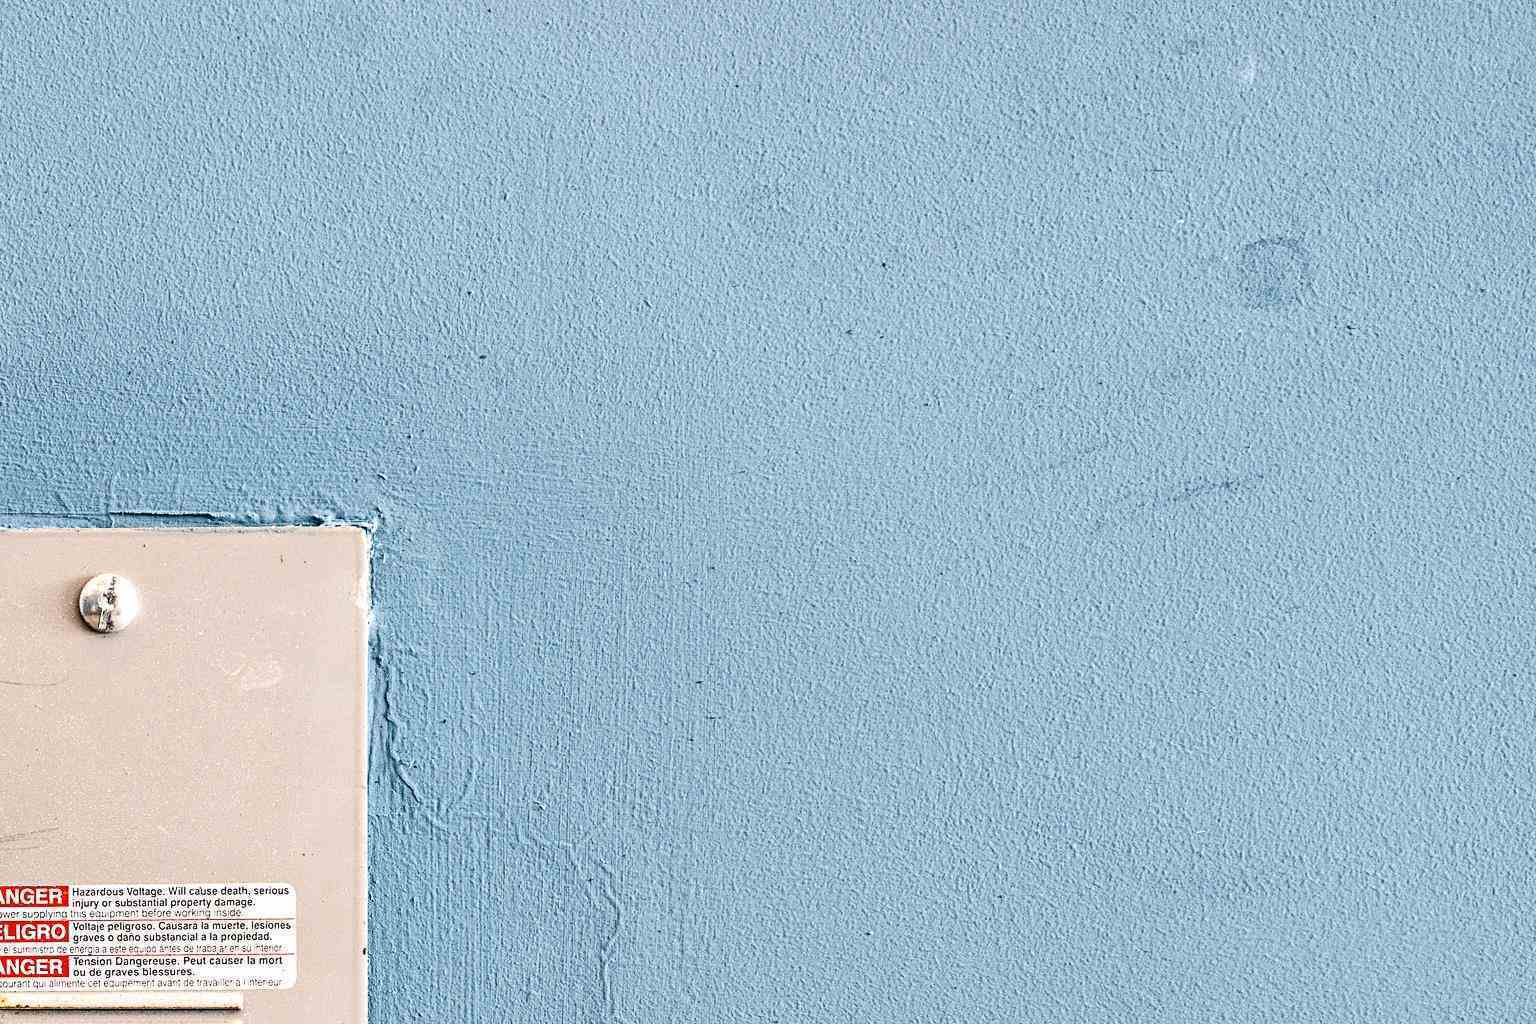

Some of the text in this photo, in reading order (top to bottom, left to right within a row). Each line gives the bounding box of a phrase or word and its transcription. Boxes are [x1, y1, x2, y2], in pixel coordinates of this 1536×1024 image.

[72, 886, 289, 898] Hazardous Voltage. Will cause death, serious
[72, 898, 256, 909] injury or substantial property damage.
[141, 909, 172, 918] before
[73, 922, 105, 932] Voltaje
[107, 921, 156, 933] peligroso.
[201, 921, 210, 930] la
[251, 921, 292, 930] lesiones
[73, 934, 105, 944] graves
[107, 934, 115, 942] o
[143, 932, 198, 942] substancial
[201, 933, 207, 941] a
[209, 932, 218, 941] la
[221, 932, 272, 942] propiedad.
[73, 956, 283, 968] Tension Dangereuse. Peut causer la mort
[73, 967, 195, 979] ou de graves blessures.
